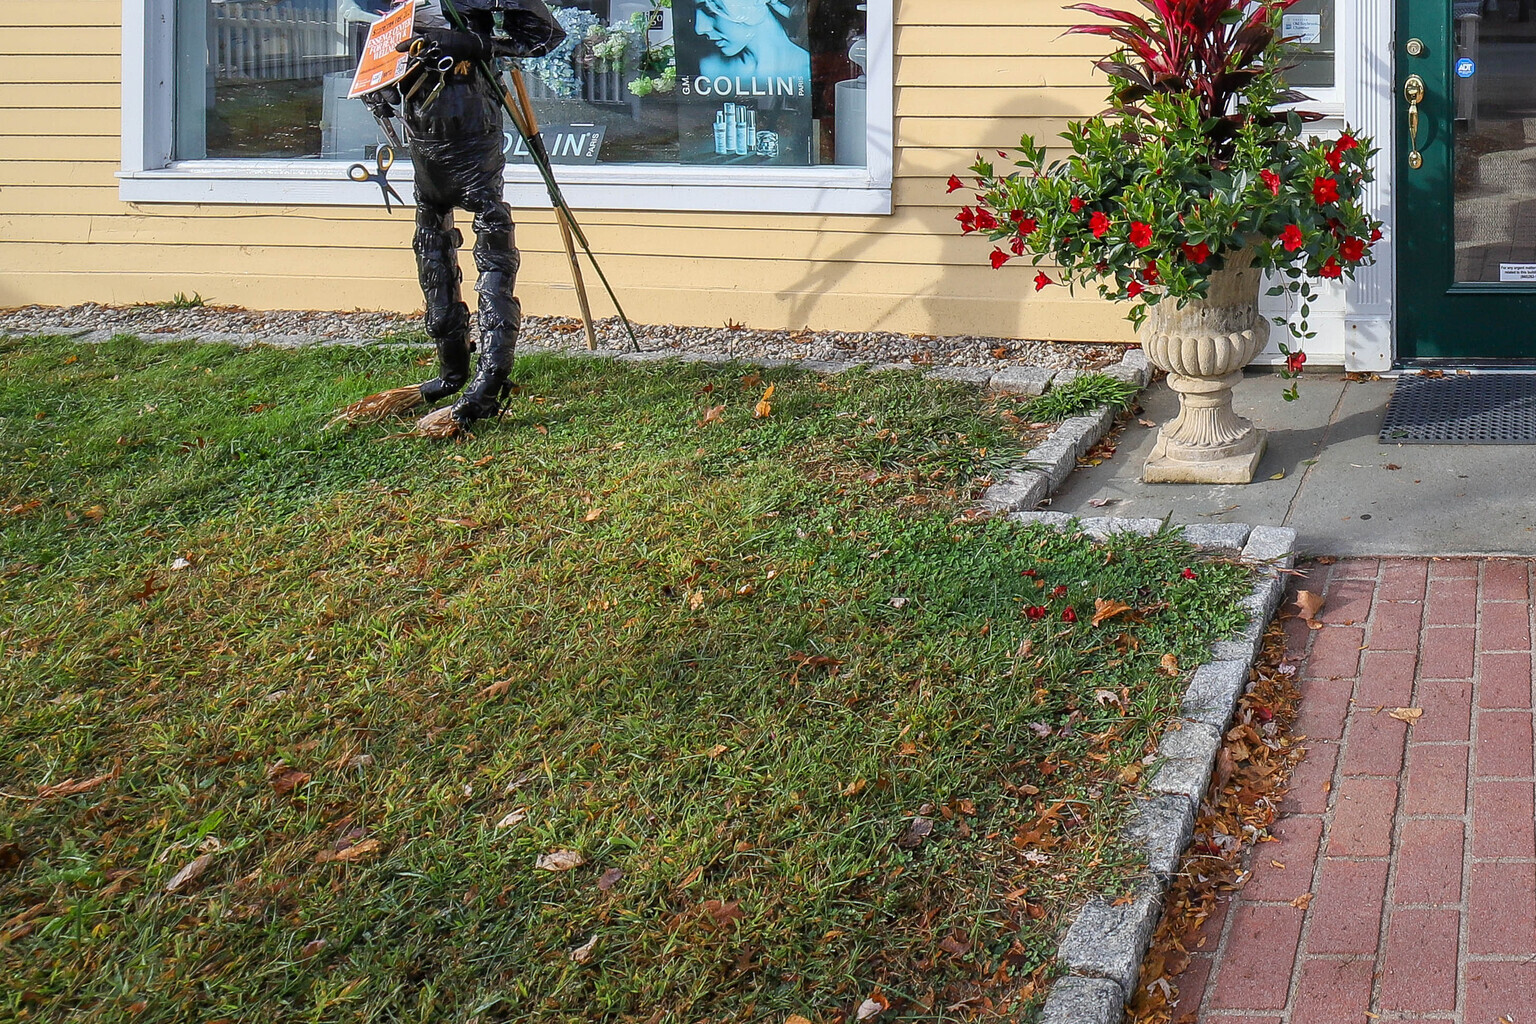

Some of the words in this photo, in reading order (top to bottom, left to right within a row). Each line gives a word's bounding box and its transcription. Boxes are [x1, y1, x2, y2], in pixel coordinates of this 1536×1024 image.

[1458, 63, 1473, 71] ADT
[681, 75, 691, 96] G.M.
[693, 75, 795, 96] COLLIN
[586, 133, 600, 157] PARIS
